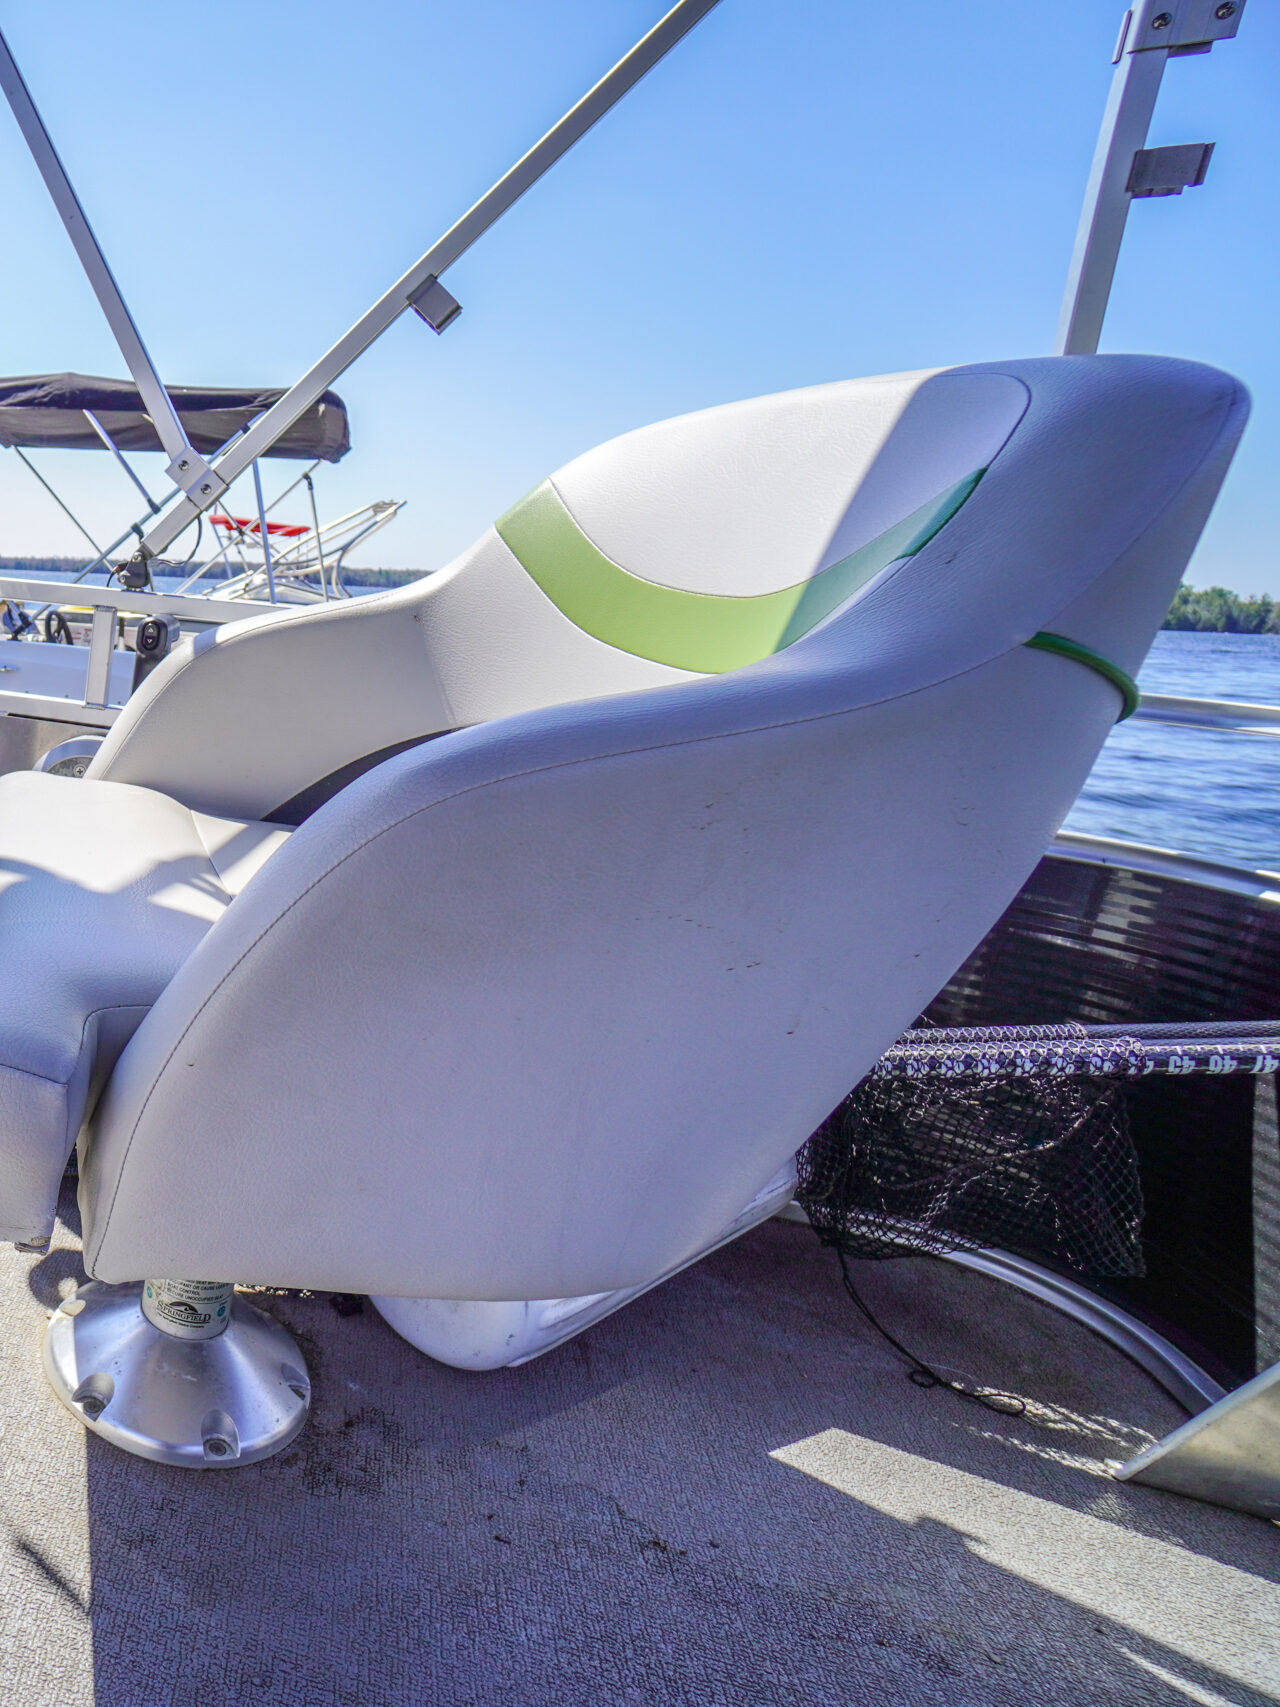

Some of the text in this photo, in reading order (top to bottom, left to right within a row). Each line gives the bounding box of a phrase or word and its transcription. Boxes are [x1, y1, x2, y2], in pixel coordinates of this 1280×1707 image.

[1166, 1055, 1196, 1075] 45
[1206, 1055, 1238, 1074] 46
[1249, 1055, 1280, 1074] 47
[179, 1287, 201, 1296] CONTROL
[157, 1300, 212, 1322] SPRINGFIELD
